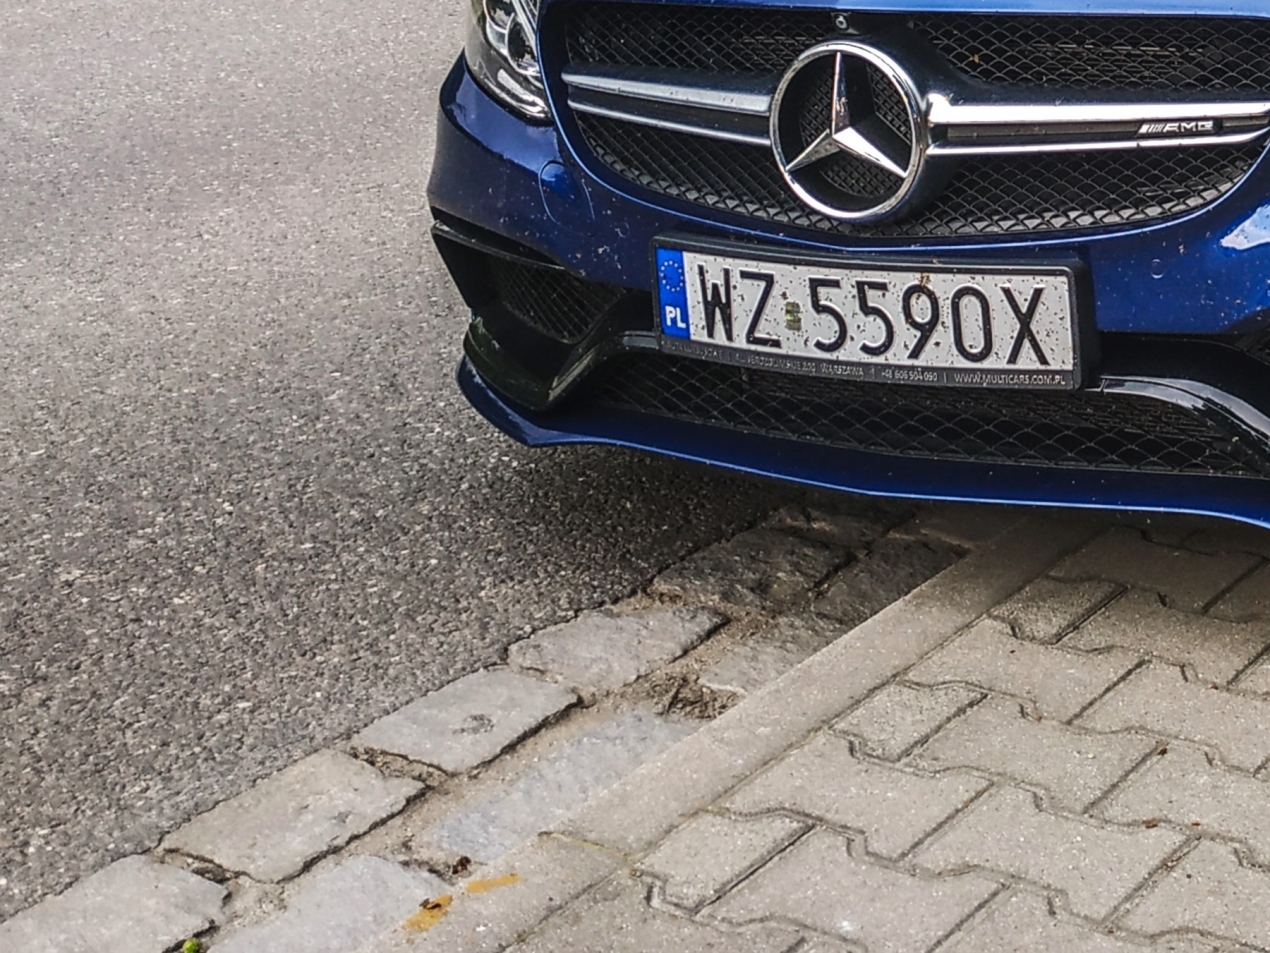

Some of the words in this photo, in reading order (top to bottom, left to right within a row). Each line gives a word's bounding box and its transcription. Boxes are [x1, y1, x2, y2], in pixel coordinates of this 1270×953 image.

[1162, 119, 1214, 133] AMG
[665, 305, 687, 329] PL
[696, 262, 783, 349] WZ
[807, 275, 1051, 367] 5590X
[954, 372, 1066, 386] WWW.MULTICARS.COM.PL
